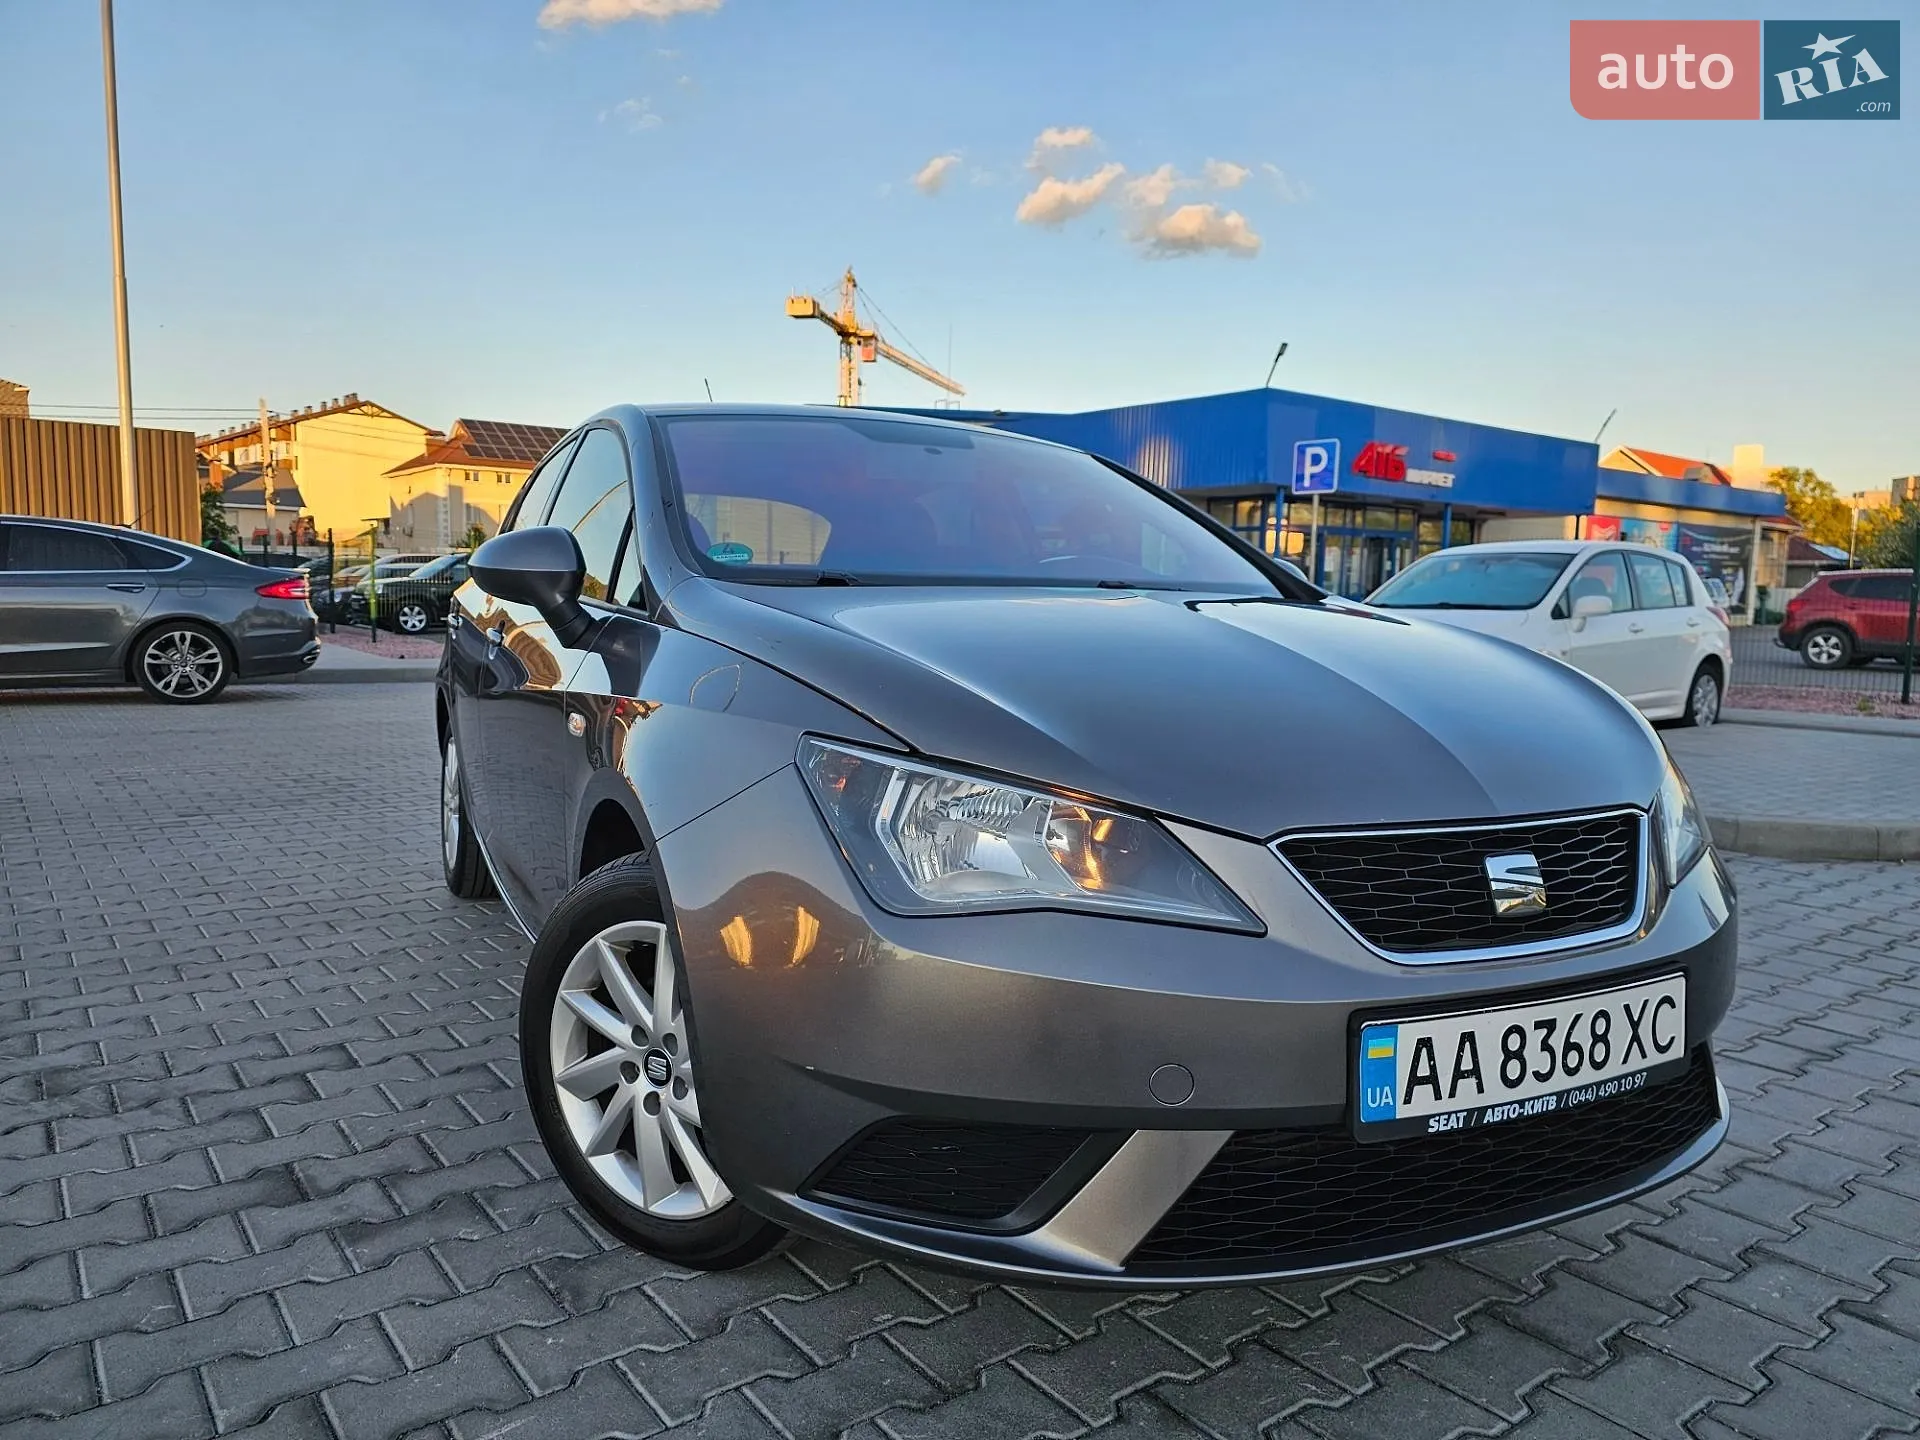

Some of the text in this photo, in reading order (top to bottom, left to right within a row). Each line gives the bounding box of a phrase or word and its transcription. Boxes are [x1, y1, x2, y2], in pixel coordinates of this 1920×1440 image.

[1304, 446, 1328, 487] P
[1500, 1008, 1611, 1089] 8368
[1367, 1087, 1393, 1108] UA
[1428, 1111, 1467, 1133] SEAT
[1483, 1095, 1557, 1124] АВТО-КИЇВ
[1569, 1085, 1597, 1108] (044)
[1599, 1080, 1618, 1098] 490
[1620, 1077, 1632, 1091] 10
[1634, 1072, 1648, 1087] 97
